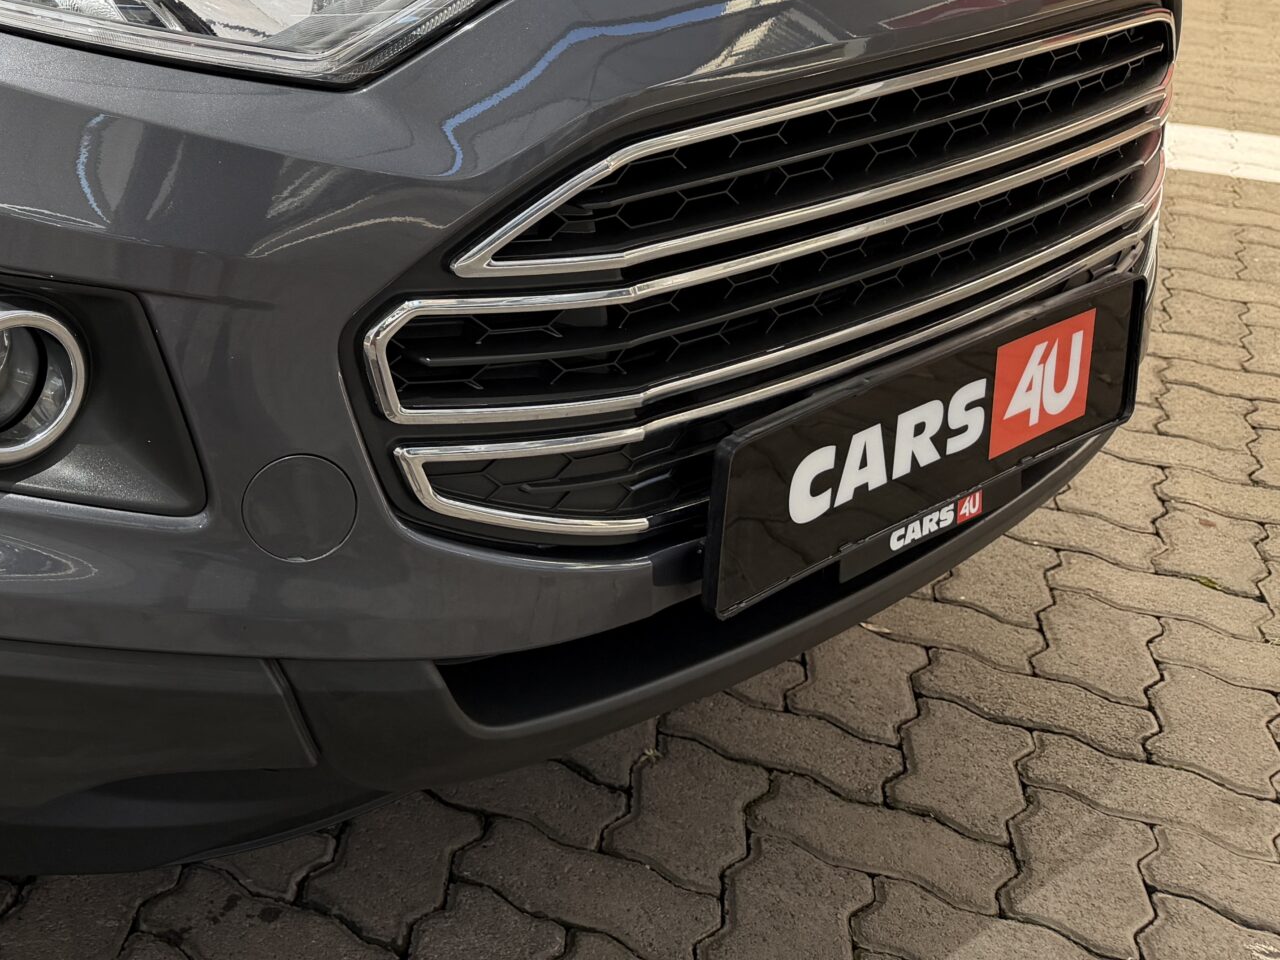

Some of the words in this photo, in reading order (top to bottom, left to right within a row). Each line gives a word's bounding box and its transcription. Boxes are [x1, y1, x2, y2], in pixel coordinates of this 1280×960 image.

[788, 378, 987, 525] CARS
[1002, 330, 1083, 427] 4U
[889, 502, 955, 552] CARS
[959, 490, 980, 517] 4U
